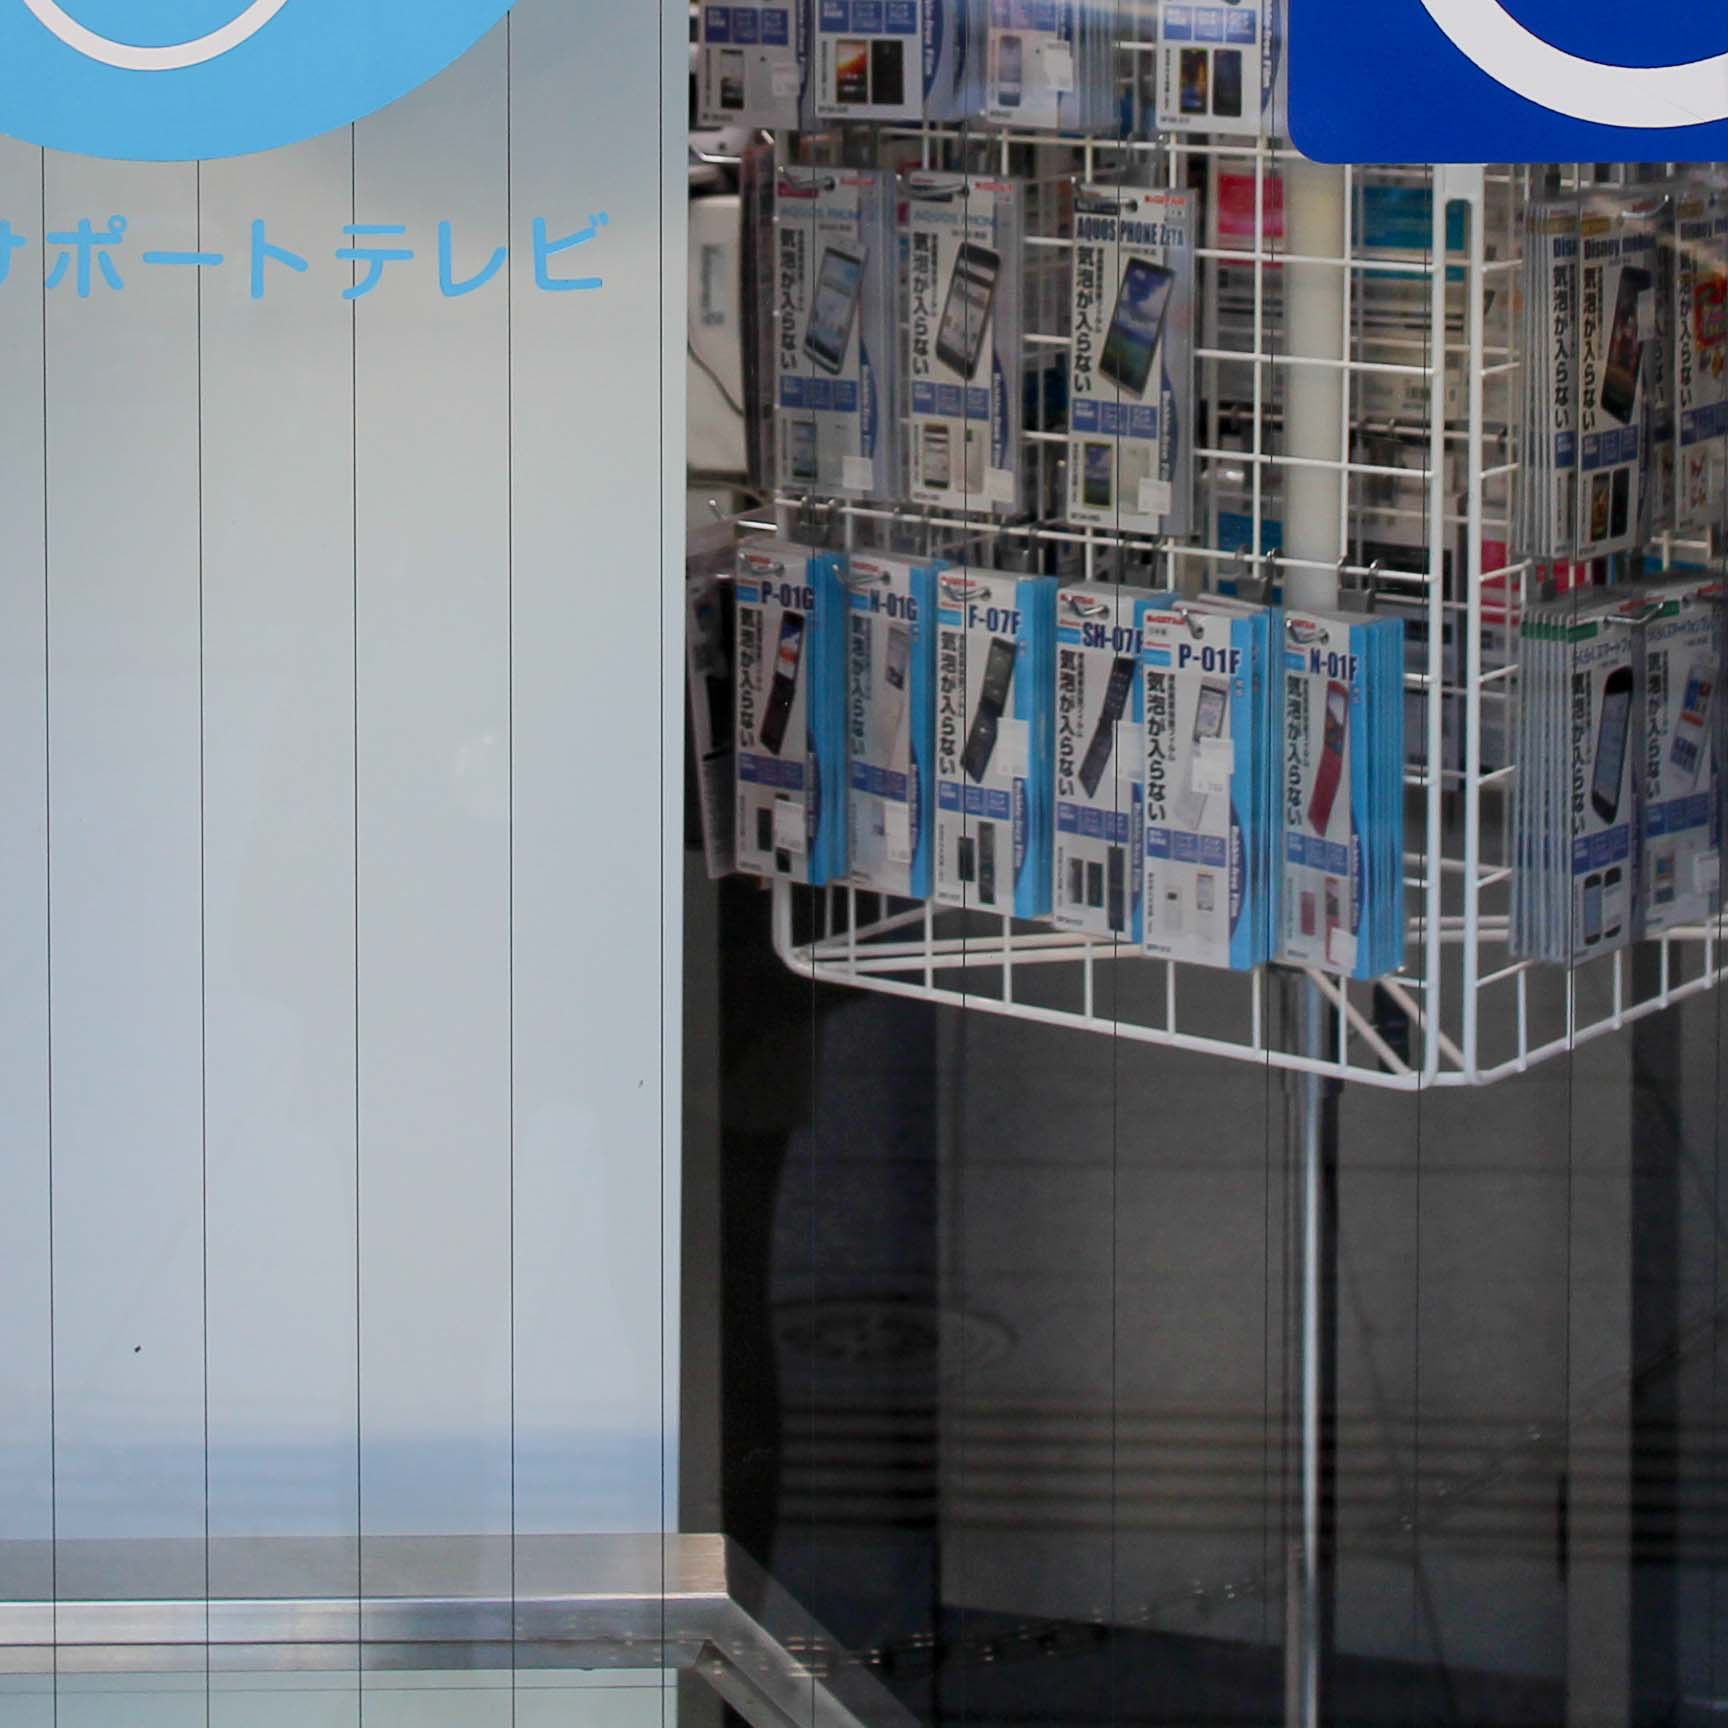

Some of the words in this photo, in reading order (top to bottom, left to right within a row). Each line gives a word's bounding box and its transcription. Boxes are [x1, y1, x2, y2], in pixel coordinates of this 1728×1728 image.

[779, 228, 797, 370] 気泡が入らない
[1076, 216, 1116, 242] AQUOS
[1119, 220, 1158, 245] PHONE
[912, 232, 930, 375] 気泡が入らない
[1074, 245, 1092, 393] 気泡が入らない
[1553, 264, 1570, 428] 気泡が入らない
[1583, 266, 1598, 429] 気泡が入らない
[760, 581, 816, 611] P-01G
[869, 588, 918, 622] N-01G
[967, 604, 1021, 635] F-07F
[1177, 642, 1241, 674] P-01F
[1309, 646, 1356, 682] N-01F
[939, 630, 958, 776] 気泡が入らない
[1058, 648, 1077, 797] 気泡が入らない
[1146, 670, 1166, 822] 気泡が入らない
[1286, 675, 1304, 827] 気泡が入らない
